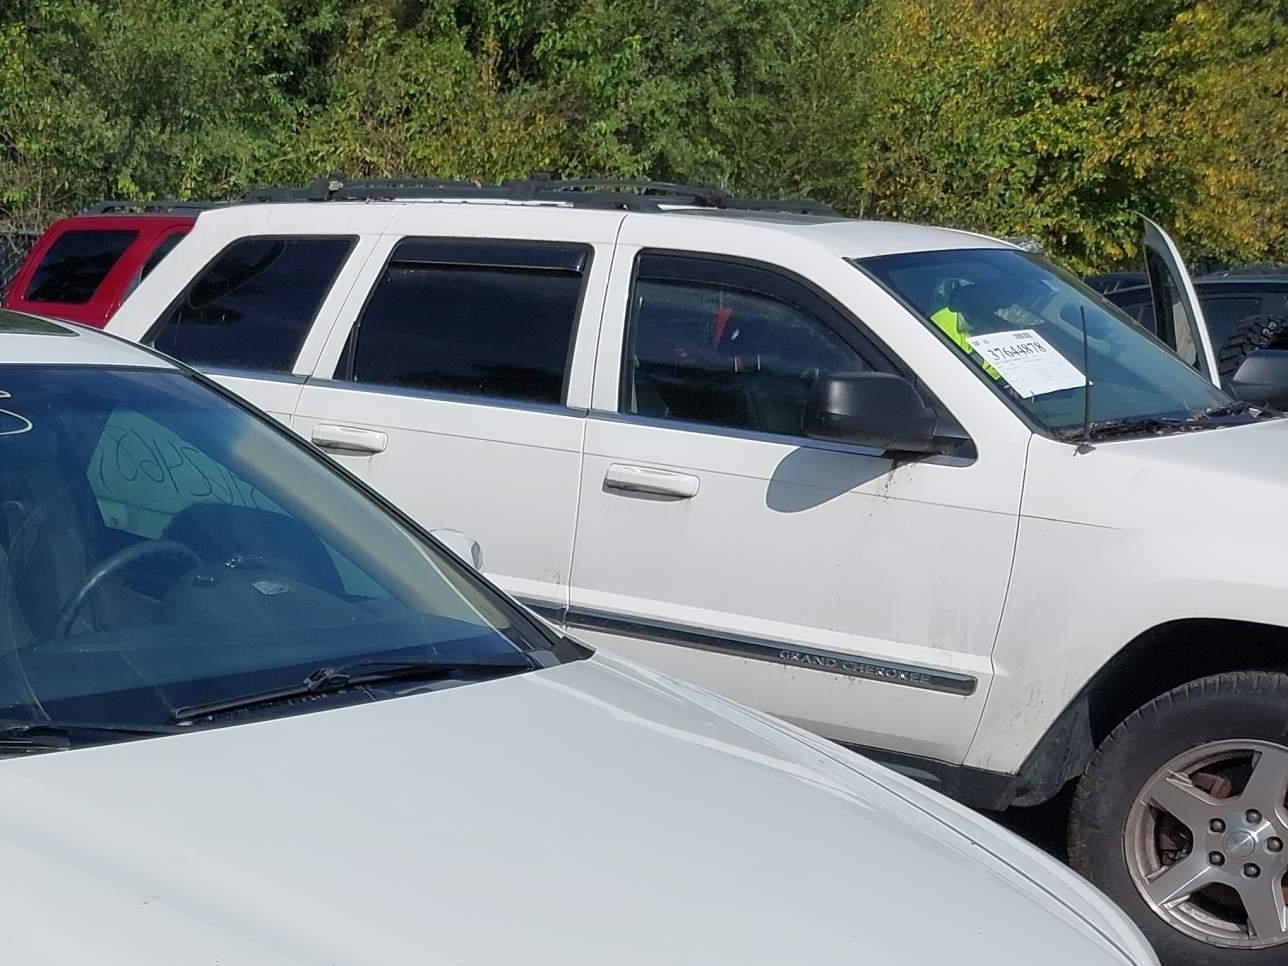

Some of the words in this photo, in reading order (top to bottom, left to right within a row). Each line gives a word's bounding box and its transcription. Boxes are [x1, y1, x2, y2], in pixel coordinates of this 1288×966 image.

[987, 342, 1047, 361] 37644878
[780, 651, 837, 667] GRAND
[842, 661, 930, 684] CHEROKEE
